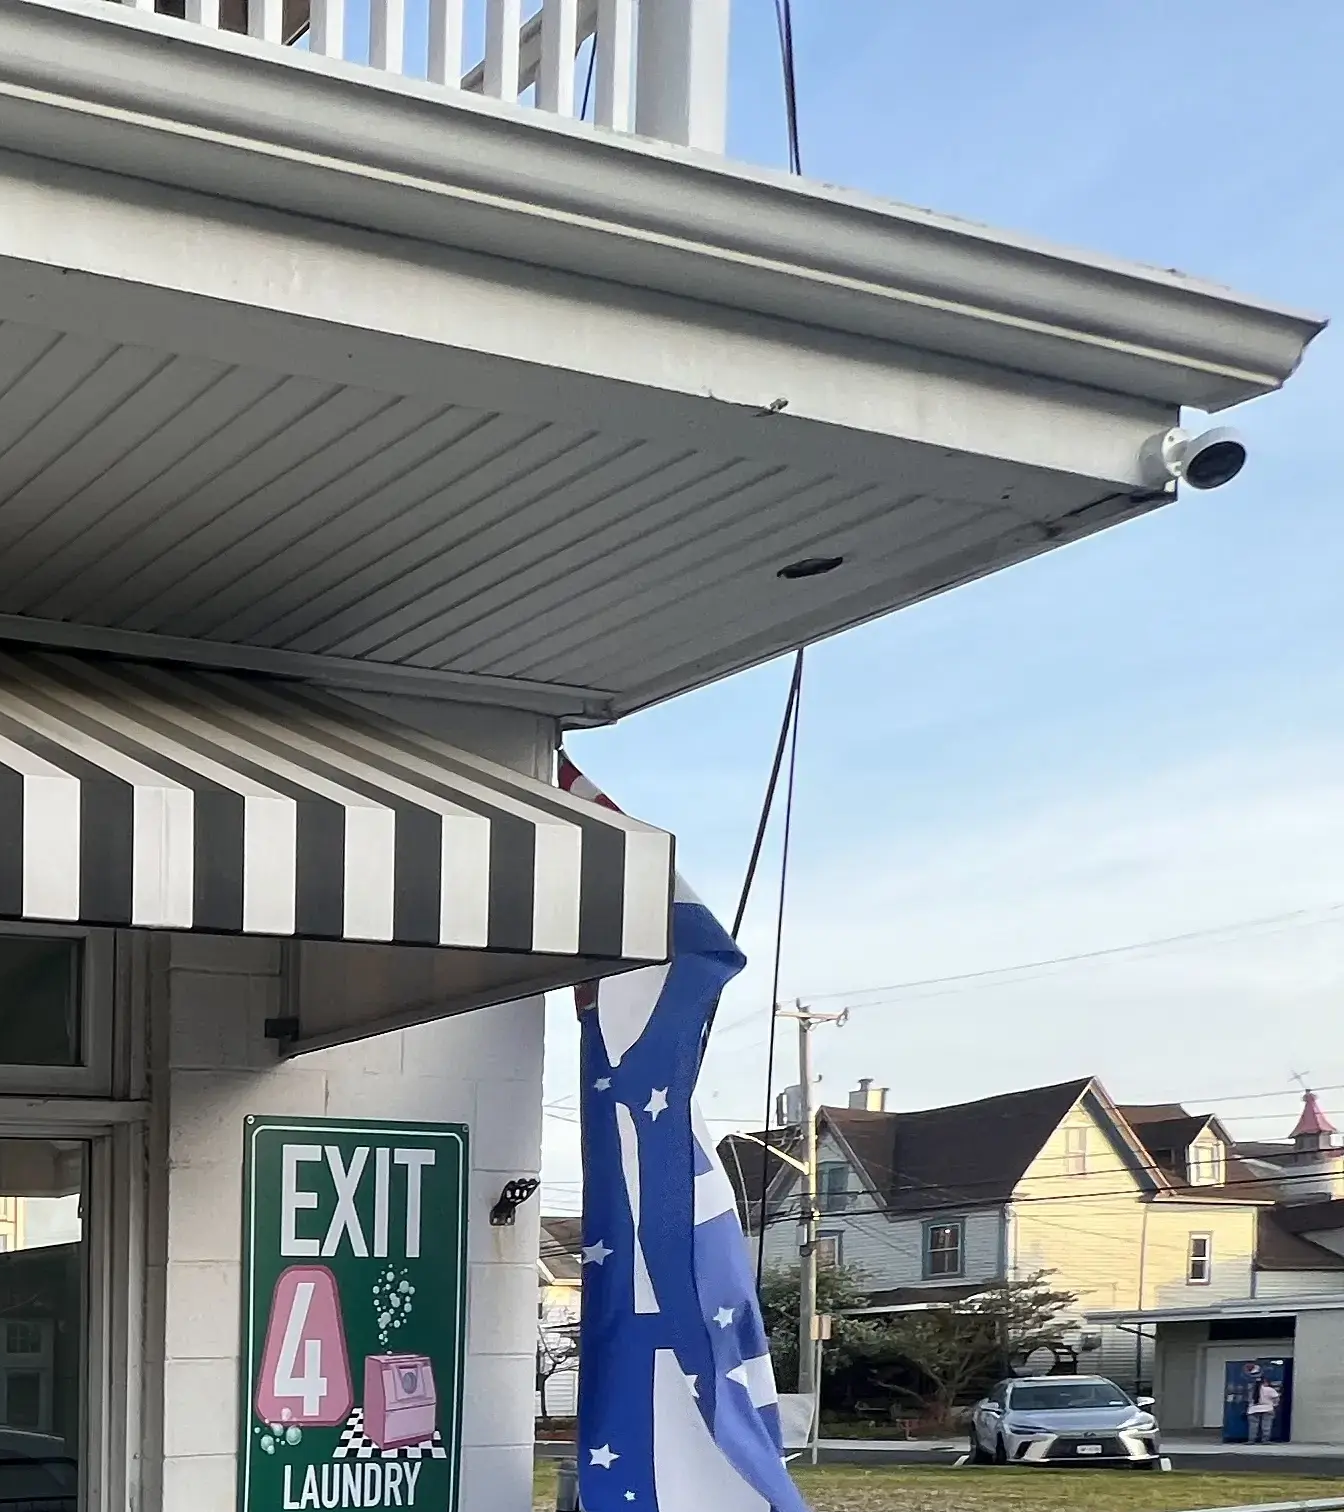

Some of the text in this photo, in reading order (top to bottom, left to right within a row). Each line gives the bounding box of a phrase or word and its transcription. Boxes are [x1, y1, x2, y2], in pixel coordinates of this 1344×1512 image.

[279, 1143, 436, 1258] EXIT
[273, 1281, 328, 1416] 4
[282, 1461, 422, 1511] LAUNDRY
